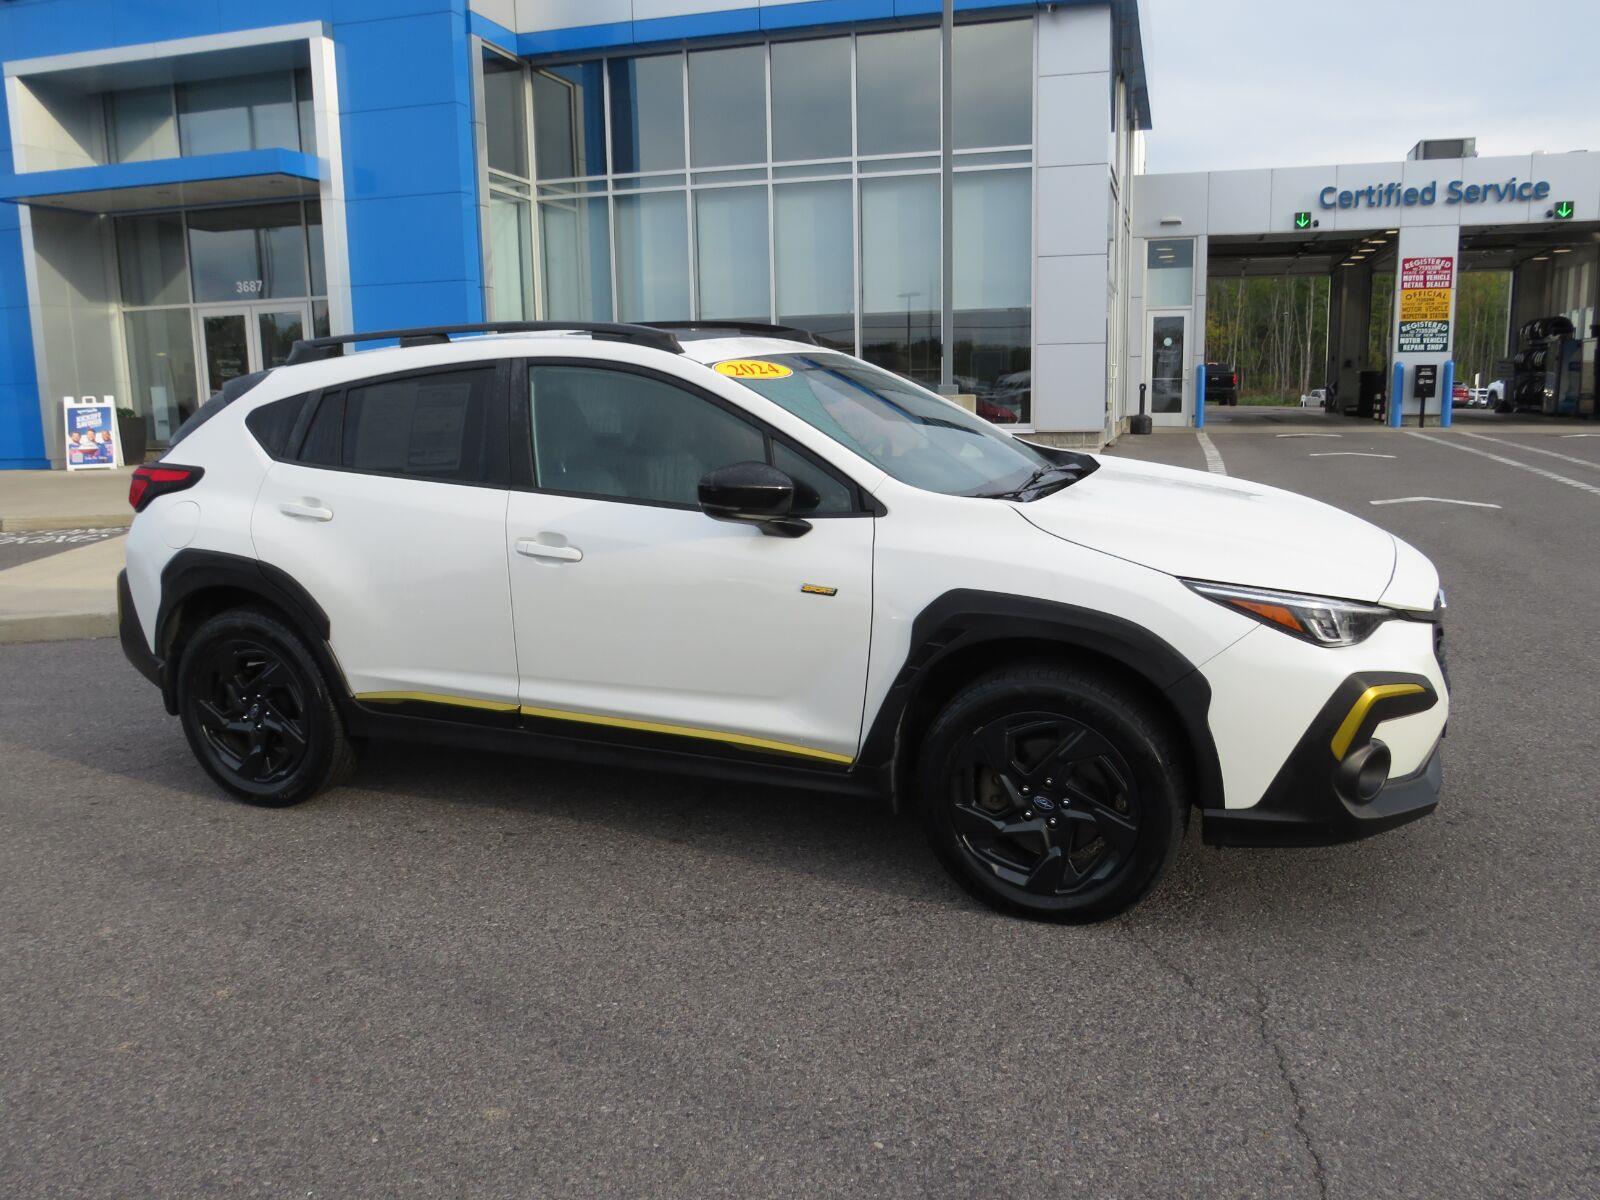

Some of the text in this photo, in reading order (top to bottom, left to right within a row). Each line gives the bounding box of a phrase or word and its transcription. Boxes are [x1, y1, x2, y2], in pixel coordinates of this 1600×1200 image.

[1319, 177, 1551, 210] Certified Service
[1404, 258, 1452, 270] REGISTERED
[236, 280, 262, 293] 3687
[1405, 290, 1447, 301] OFFICIAL
[1401, 321, 1448, 333] REGISTERED
[1427, 343, 1444, 351] SHOP
[726, 363, 780, 376] 2024
